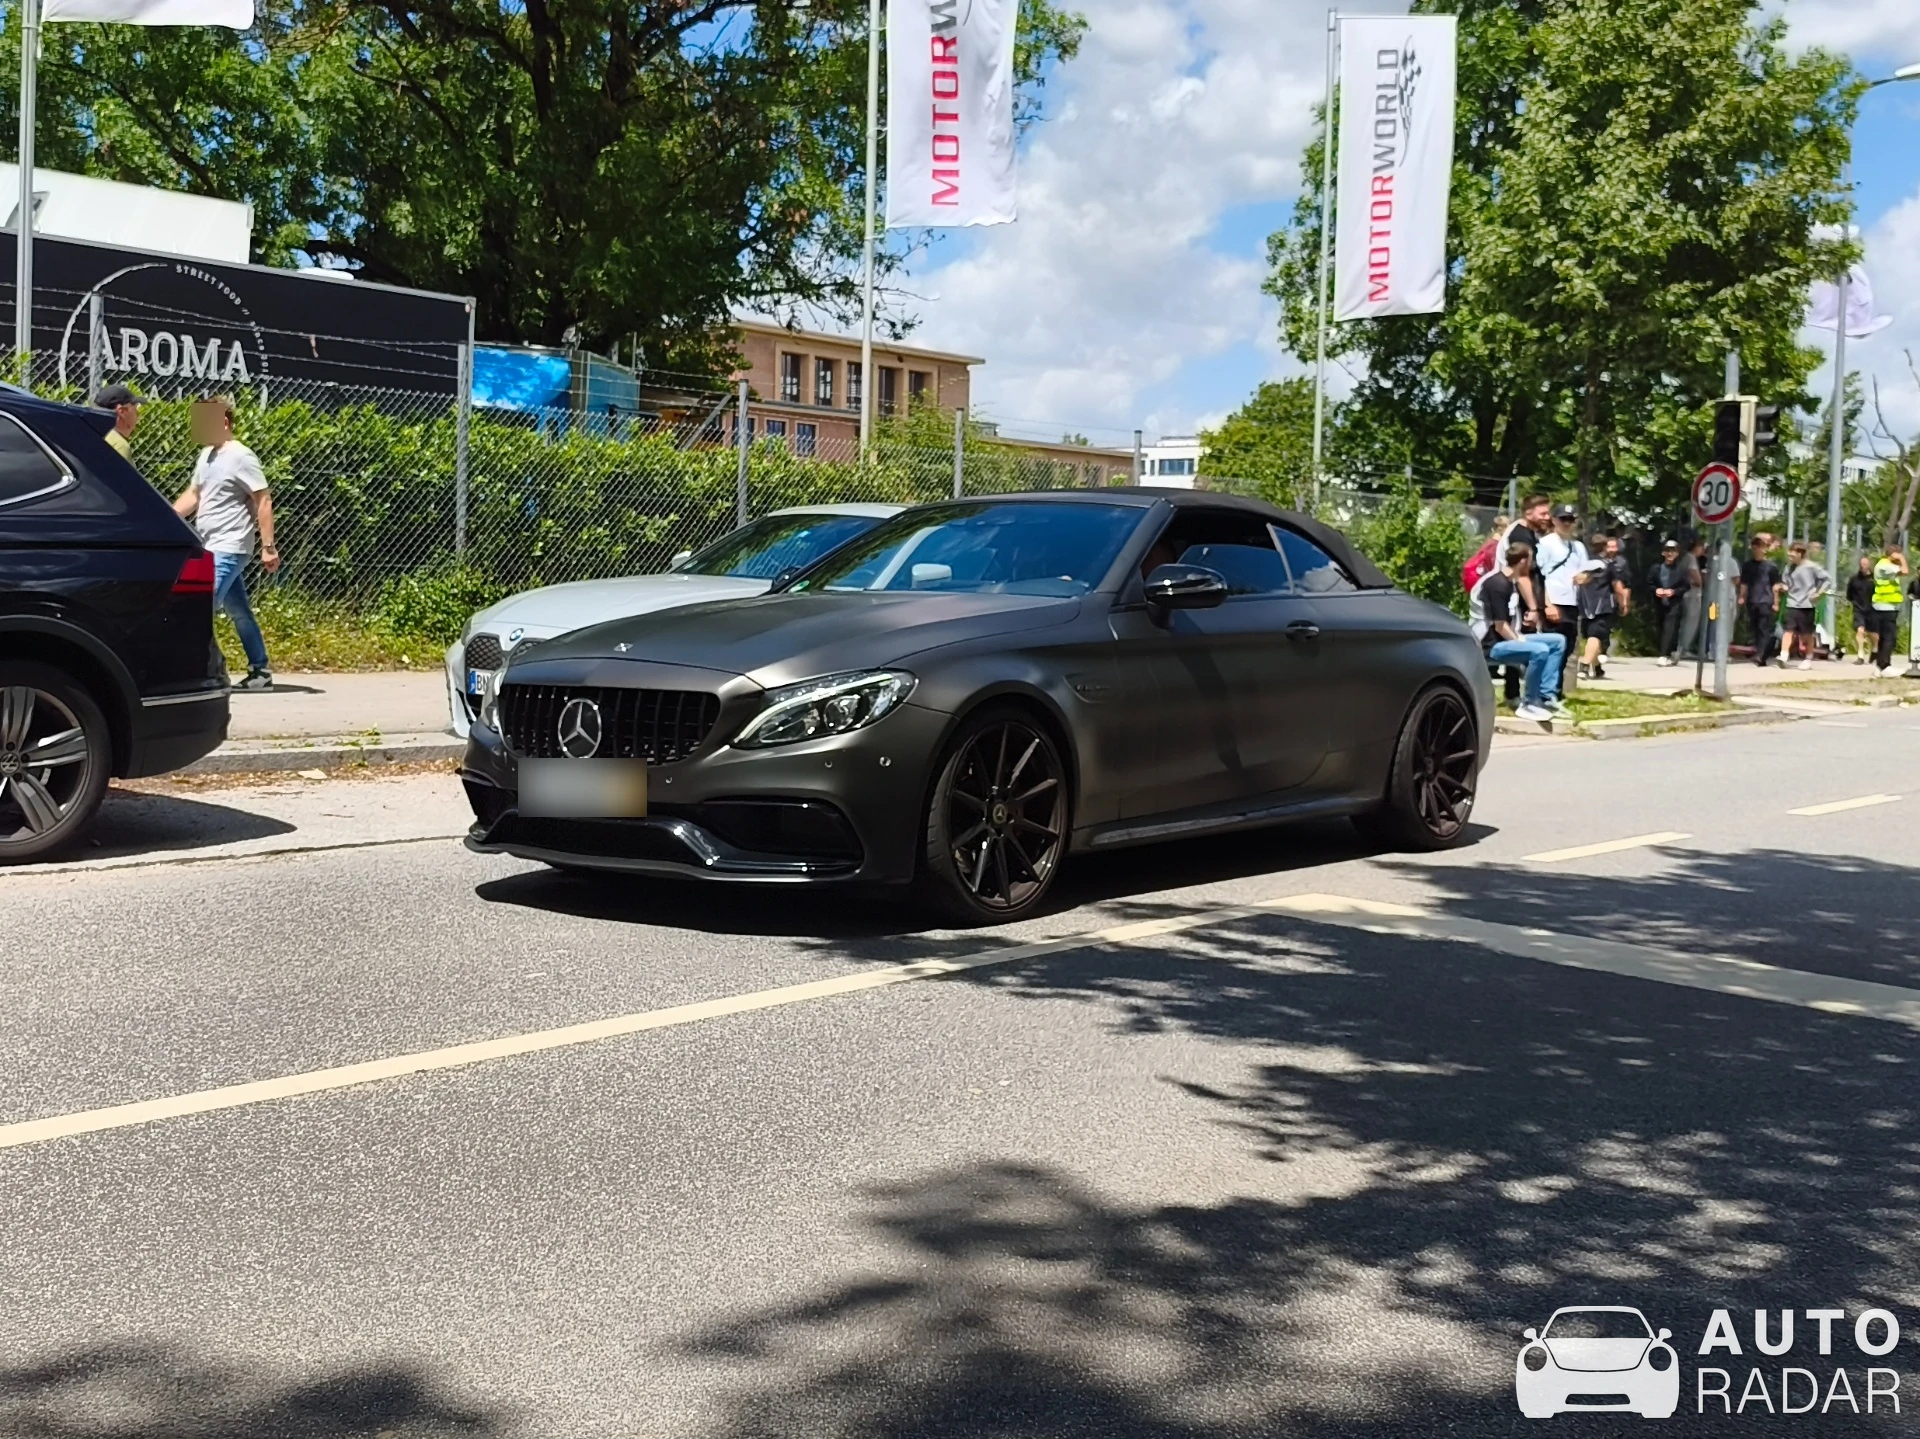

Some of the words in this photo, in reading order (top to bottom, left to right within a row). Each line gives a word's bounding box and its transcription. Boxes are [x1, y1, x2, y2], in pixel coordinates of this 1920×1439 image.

[1368, 49, 1400, 302] MOTORWORLD
[176, 264, 217, 285] STREET
[217, 281, 242, 306] FOOD
[85, 324, 251, 383] AROMA
[1701, 481, 1729, 506] 30
